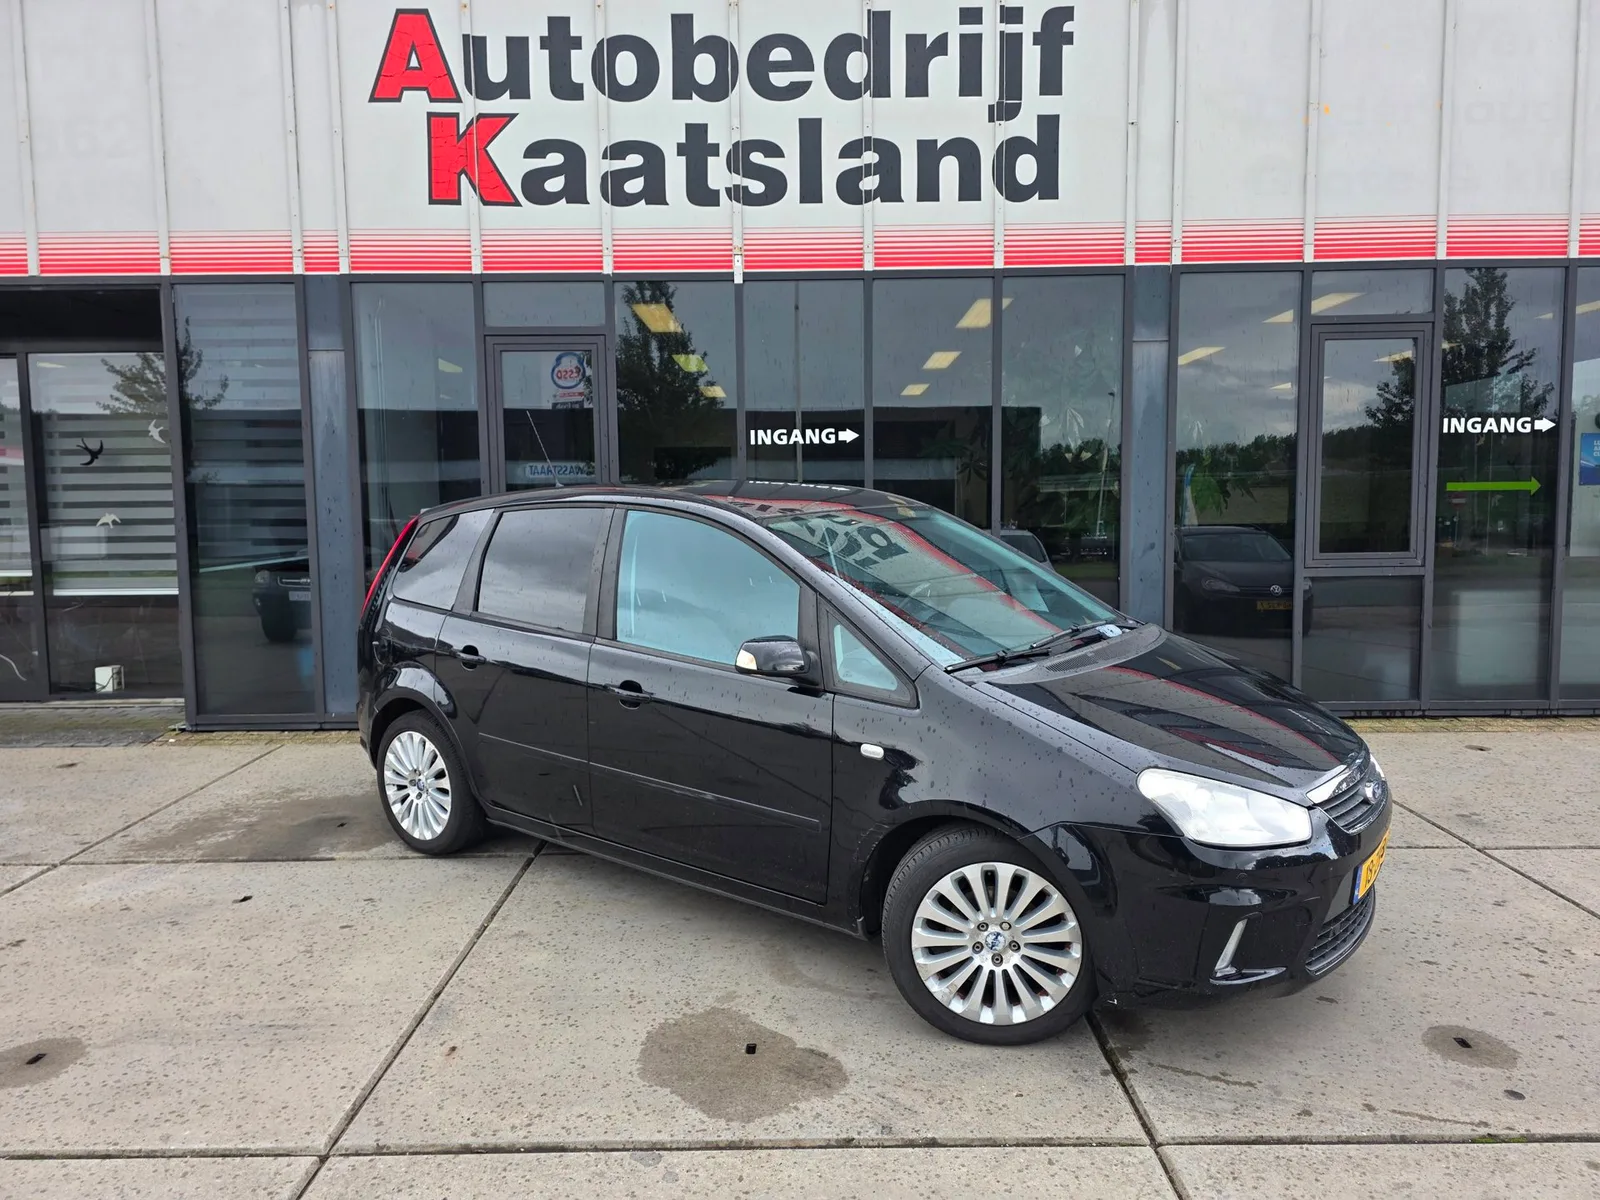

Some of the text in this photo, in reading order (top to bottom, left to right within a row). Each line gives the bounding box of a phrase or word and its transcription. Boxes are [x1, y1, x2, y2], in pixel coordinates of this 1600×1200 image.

[367, 4, 1075, 123] Autobedrijf
[426, 111, 1061, 207] Kaatsland
[749, 428, 836, 446] INGANG
[1442, 416, 1532, 434] INGANG
